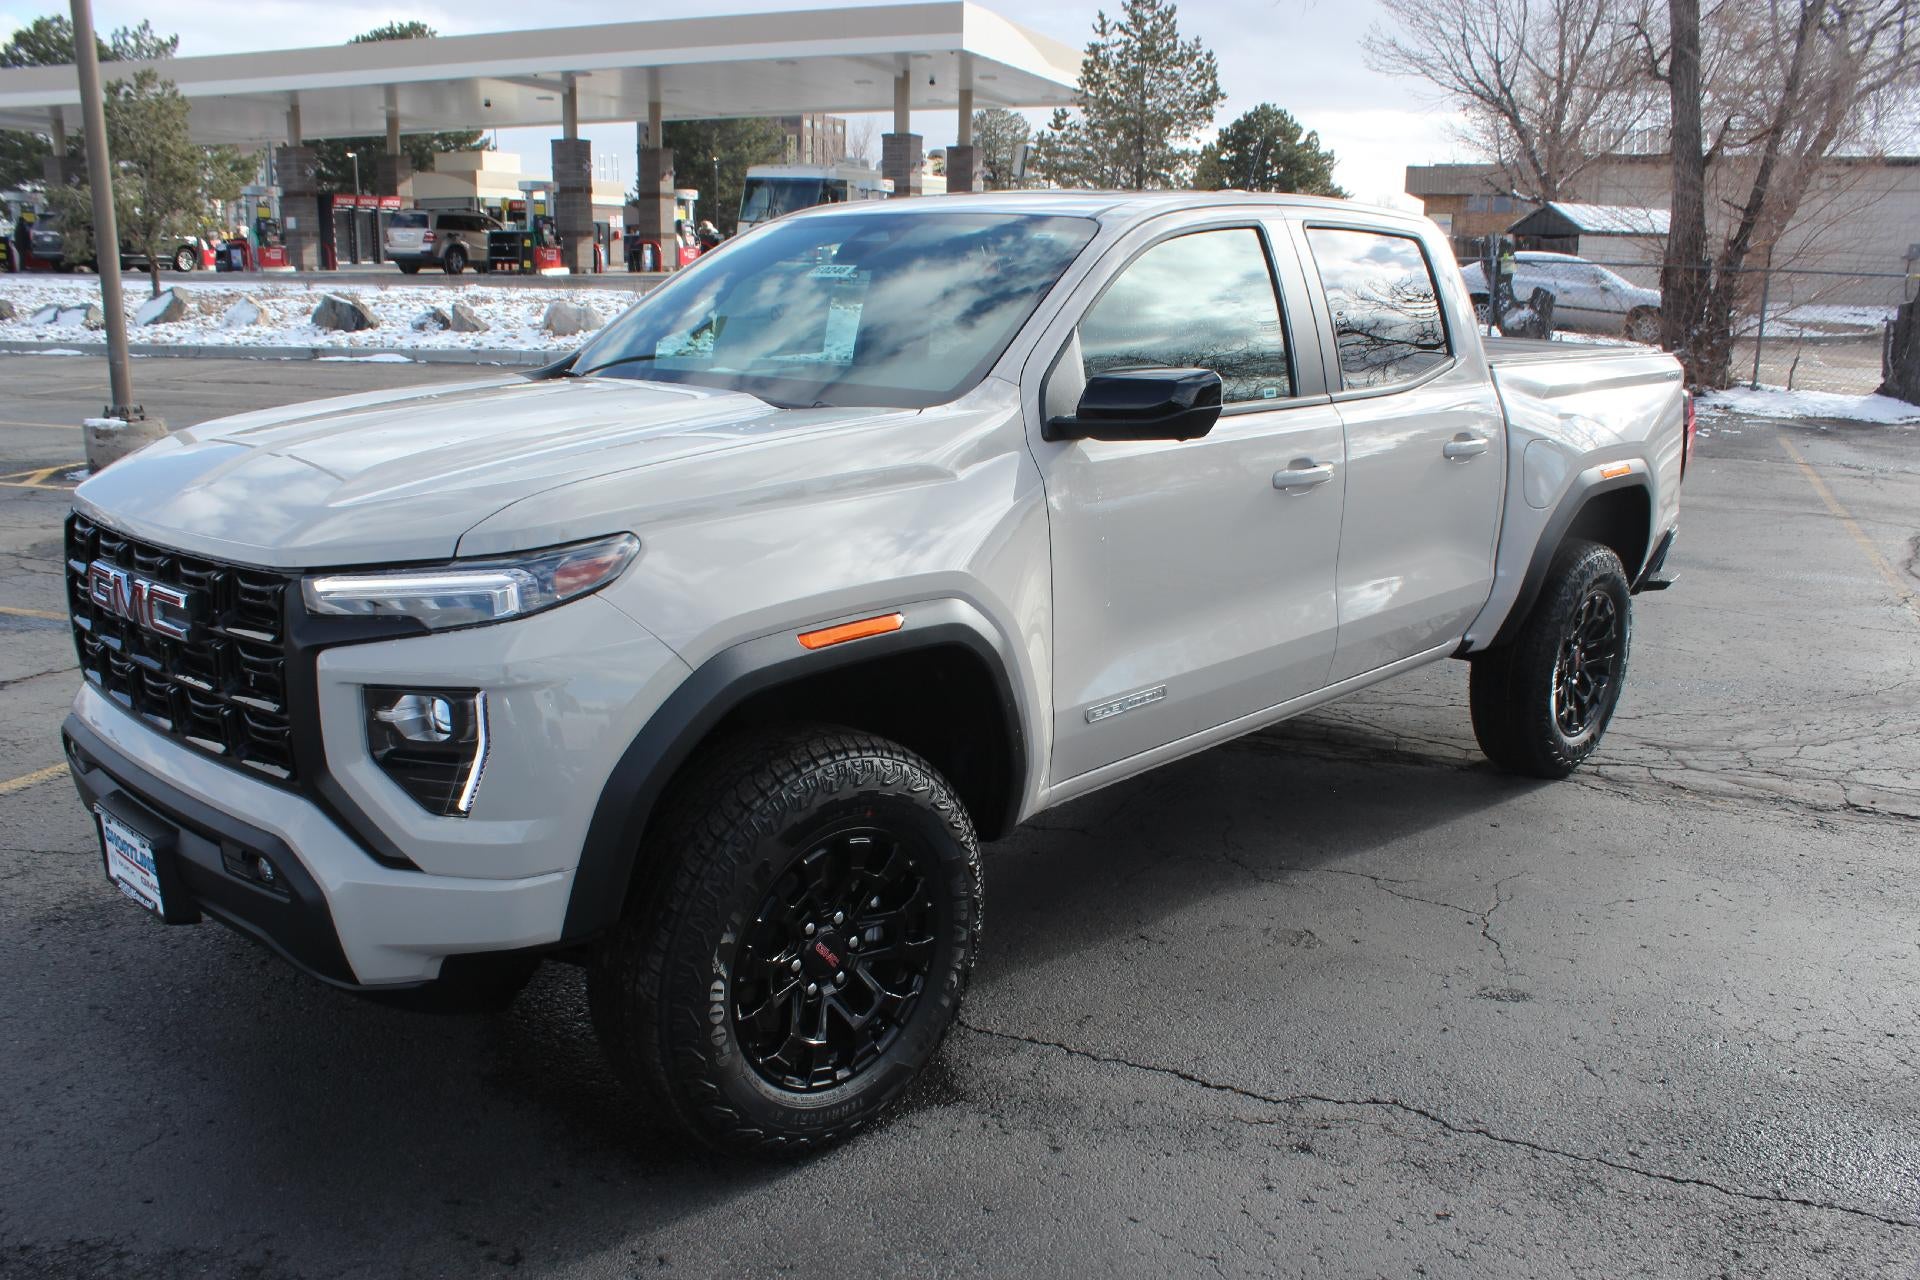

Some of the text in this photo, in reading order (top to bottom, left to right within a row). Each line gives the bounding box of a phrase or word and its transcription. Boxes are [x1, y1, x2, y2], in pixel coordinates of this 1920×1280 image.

[88, 559, 188, 641] GMC
[105, 825, 157, 876] SHORTLINE
[815, 941, 840, 968] GMC
